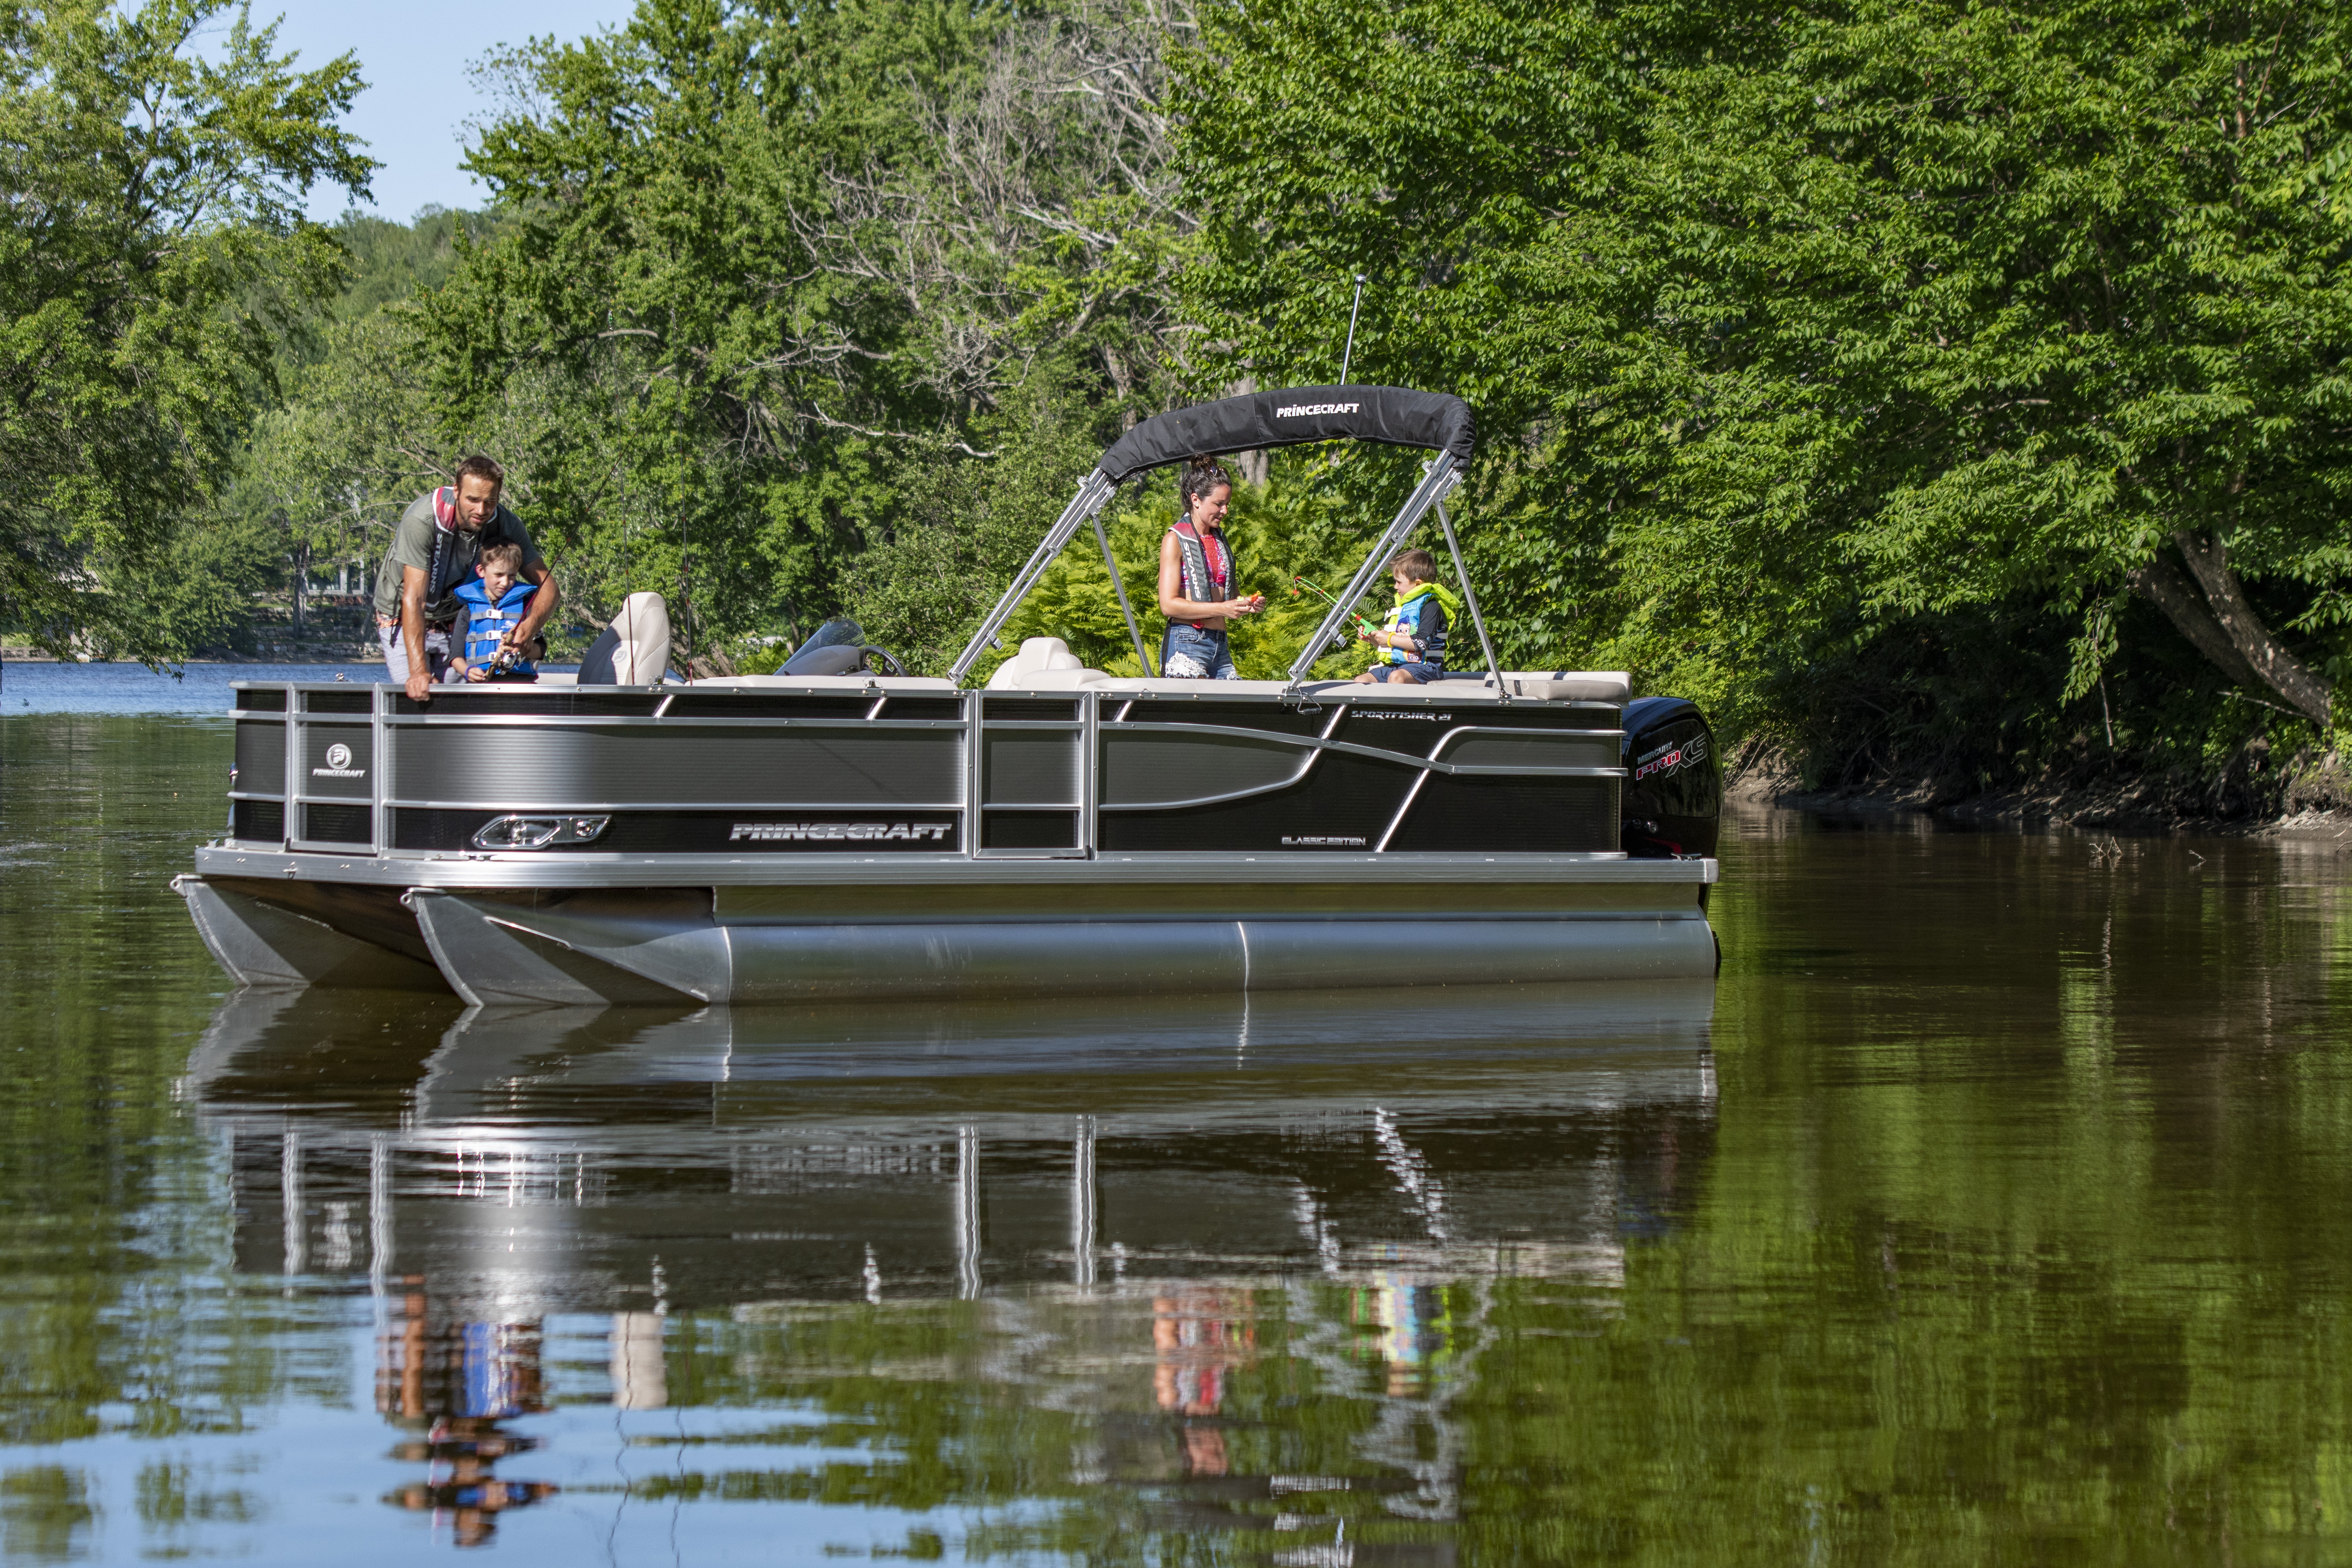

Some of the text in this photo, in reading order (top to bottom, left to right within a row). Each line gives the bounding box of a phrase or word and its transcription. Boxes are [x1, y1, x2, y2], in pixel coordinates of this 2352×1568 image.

[429, 533, 443, 595] STEARNS
[1183, 542, 1201, 600] STEARNS
[1351, 710, 1437, 722] SPORTFISHER
[1637, 741, 1673, 765] MERCURY
[312, 768, 366, 778] PRINCECRAFT
[729, 823, 953, 841] PRINCECRAFT
[1282, 836, 1367, 846] CLASSIC EDITION
